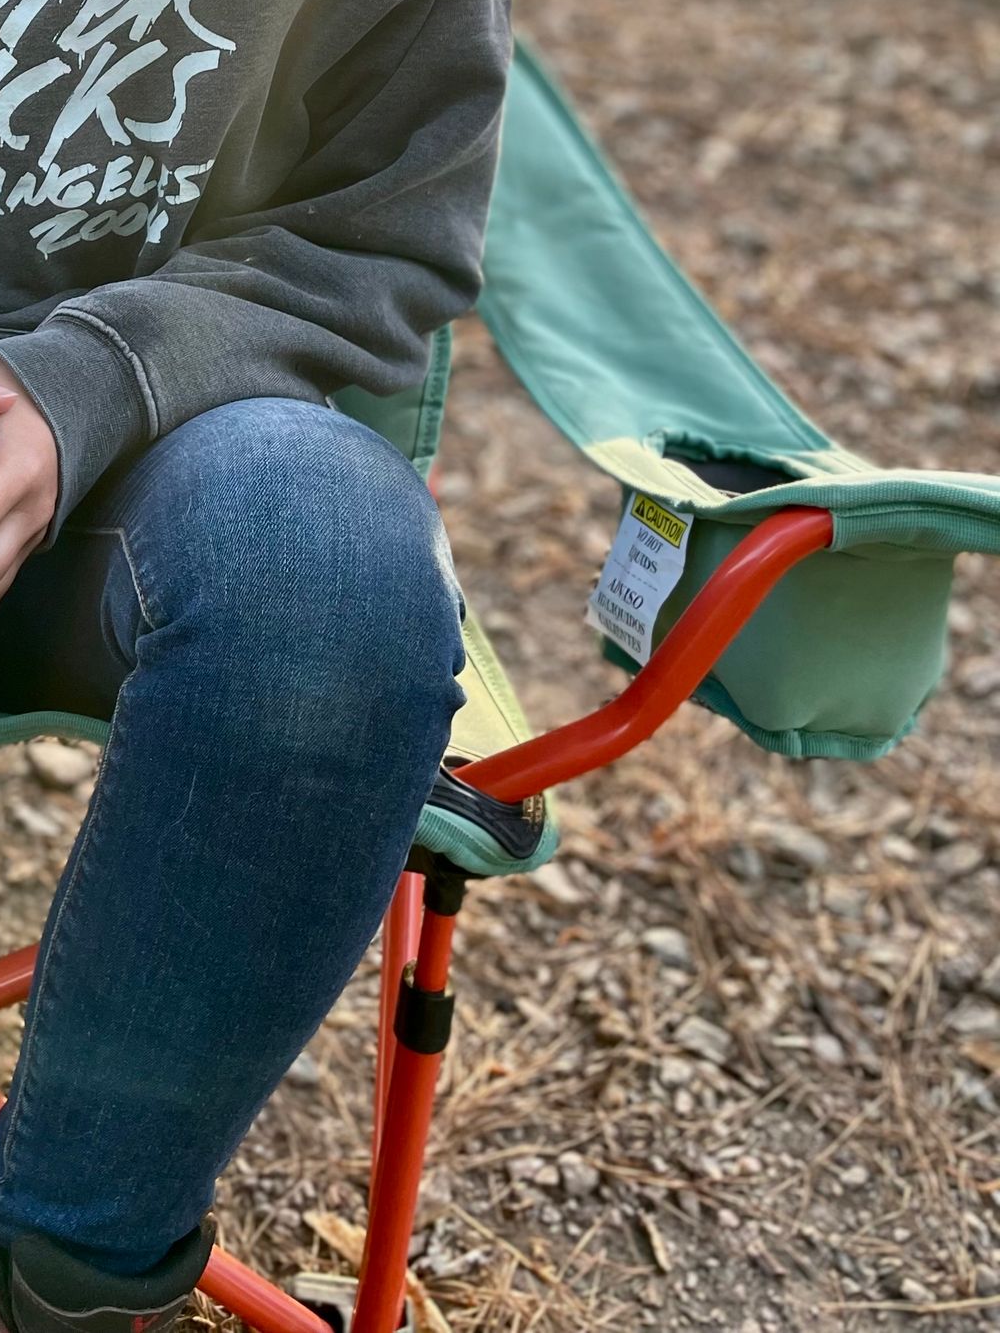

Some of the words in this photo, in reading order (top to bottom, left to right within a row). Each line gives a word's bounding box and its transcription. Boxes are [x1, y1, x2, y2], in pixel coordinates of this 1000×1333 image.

[645, 505, 682, 542] CAUTION
[644, 535, 664, 554] HOT
[608, 578, 644, 610] AVISO
